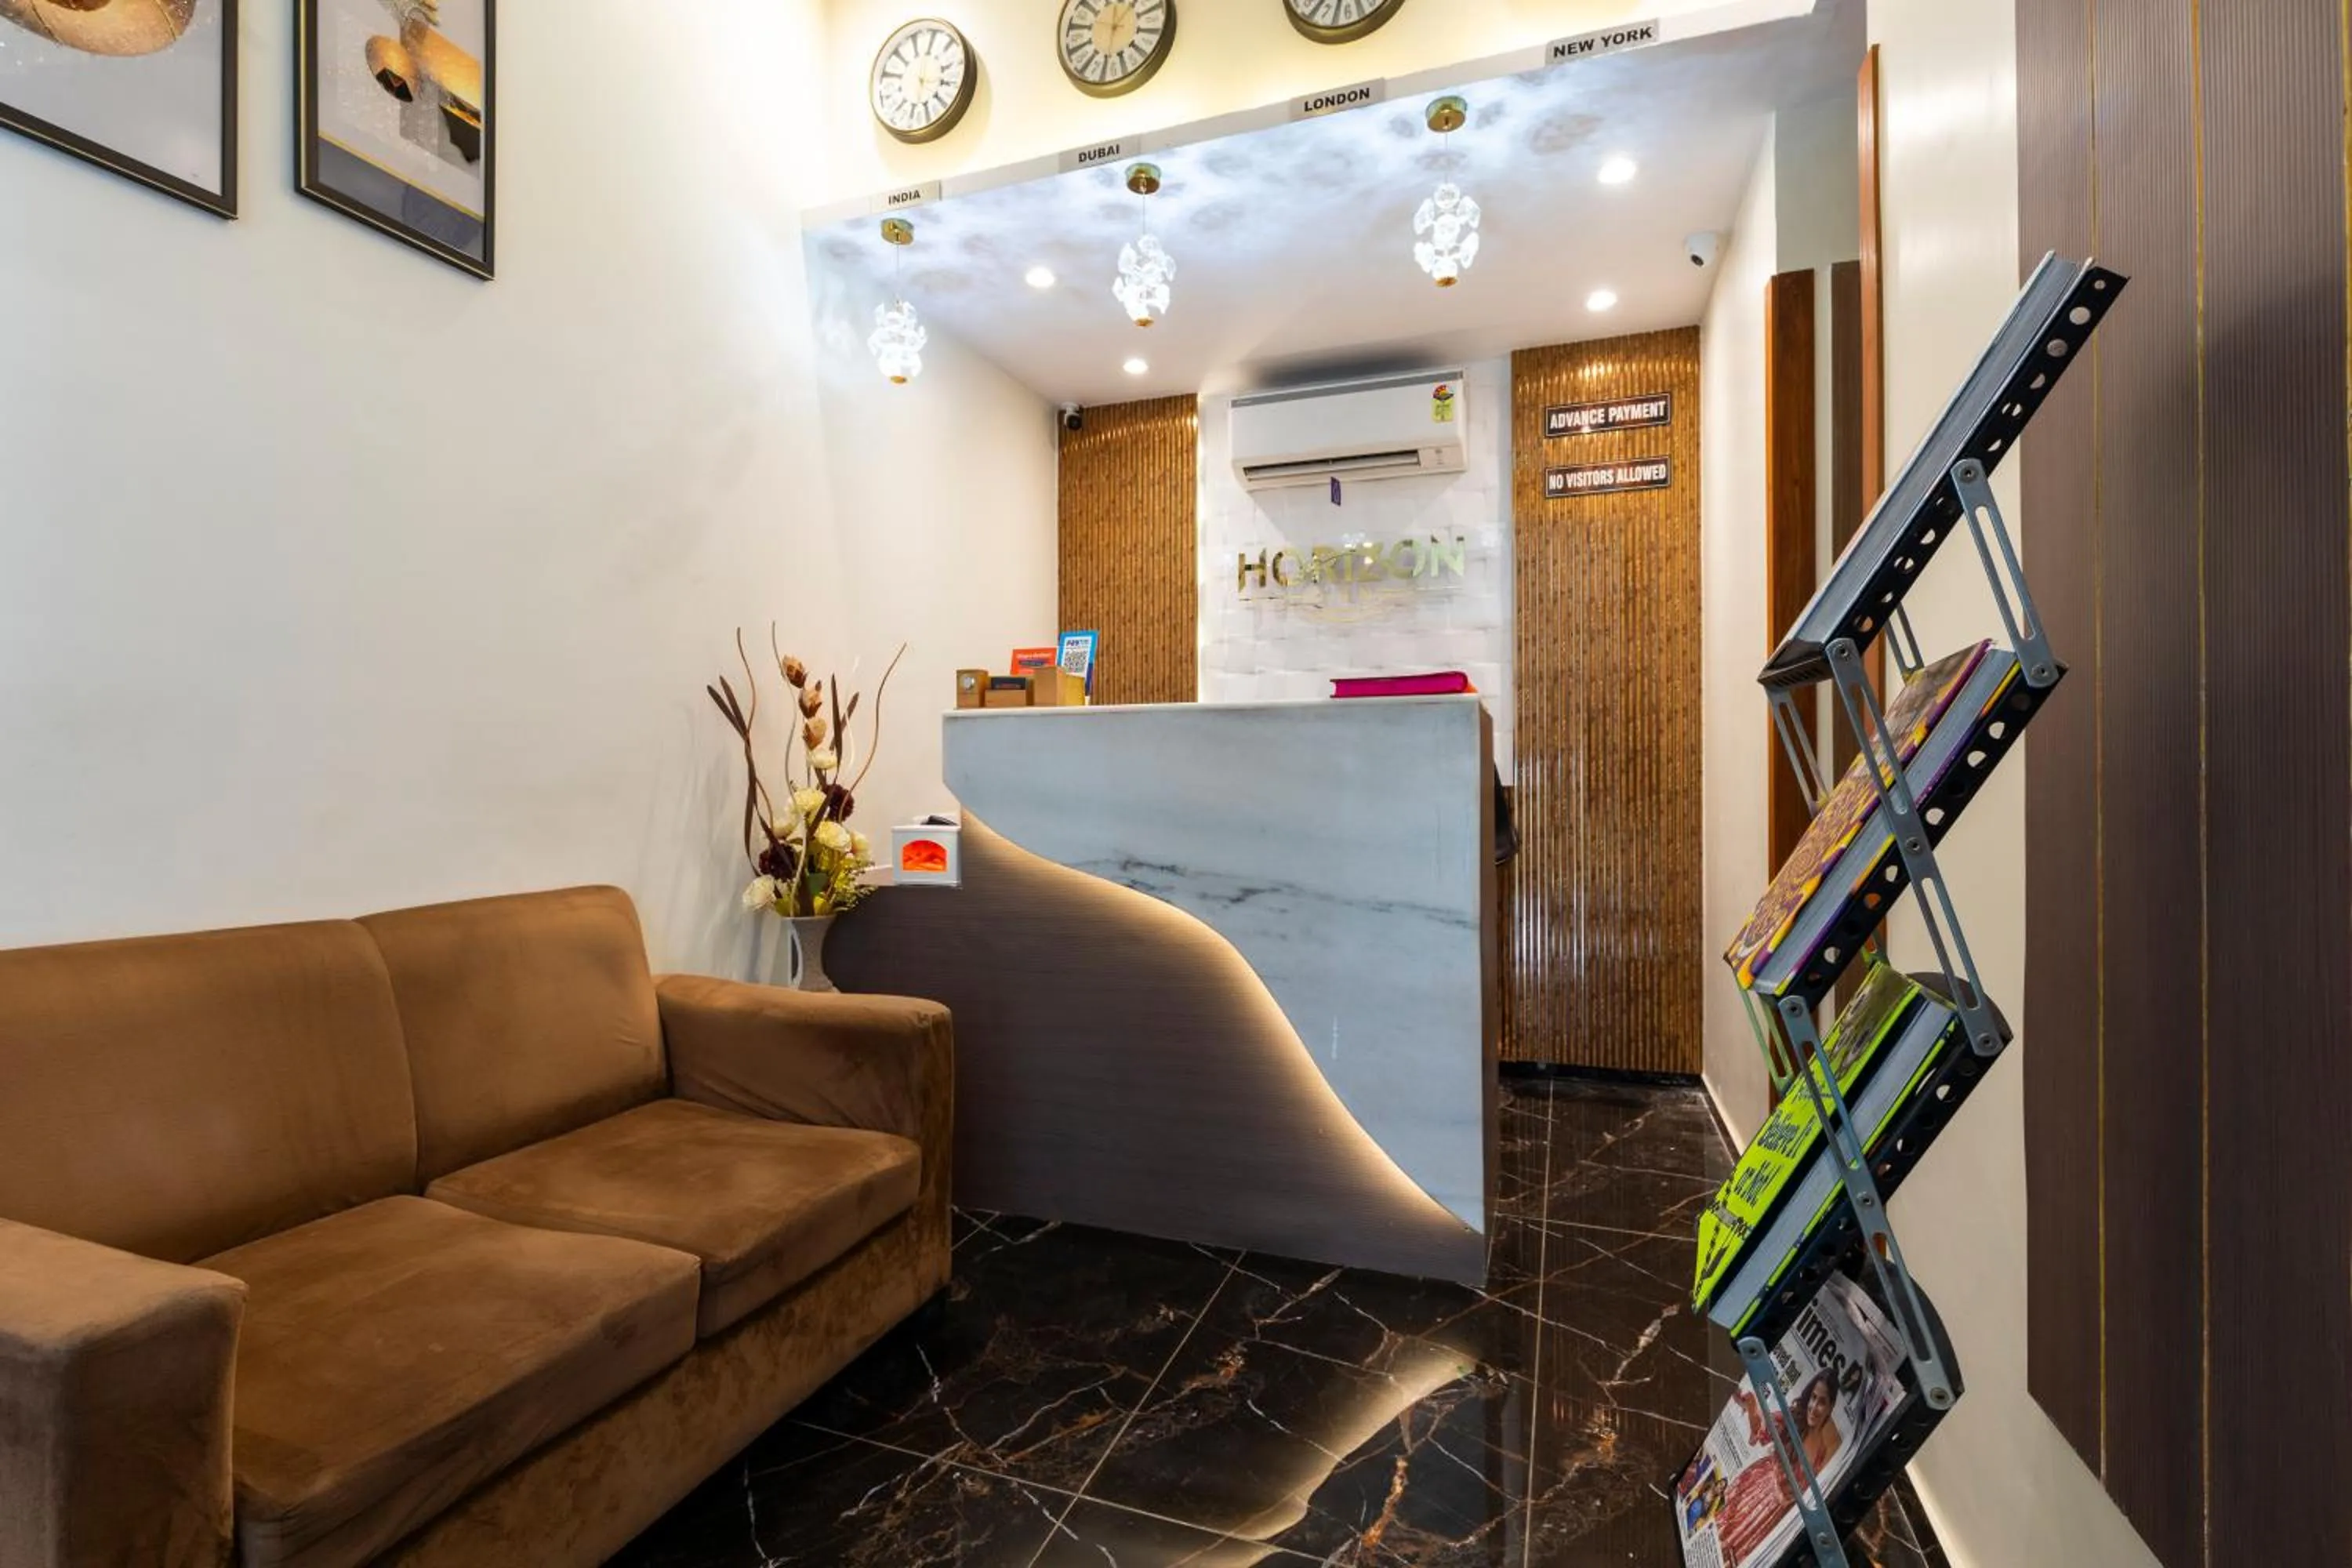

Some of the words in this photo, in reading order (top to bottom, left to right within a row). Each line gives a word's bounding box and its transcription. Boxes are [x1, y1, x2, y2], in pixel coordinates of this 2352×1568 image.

[1554, 38, 1595, 58] NEW
[1600, 27, 1653, 47] YORK
[1304, 87, 1370, 112] LONDON
[1078, 143, 1120, 163] DUBAI
[888, 189, 920, 206] INDIA
[1549, 408, 1605, 430] ADVANCE
[1608, 401, 1666, 423] PAYMENT
[1548, 474, 1564, 490] NO
[1566, 470, 1614, 488] VISITORS
[1616, 464, 1666, 483] ALLOWED
[1237, 535, 1465, 593] HORIZON
